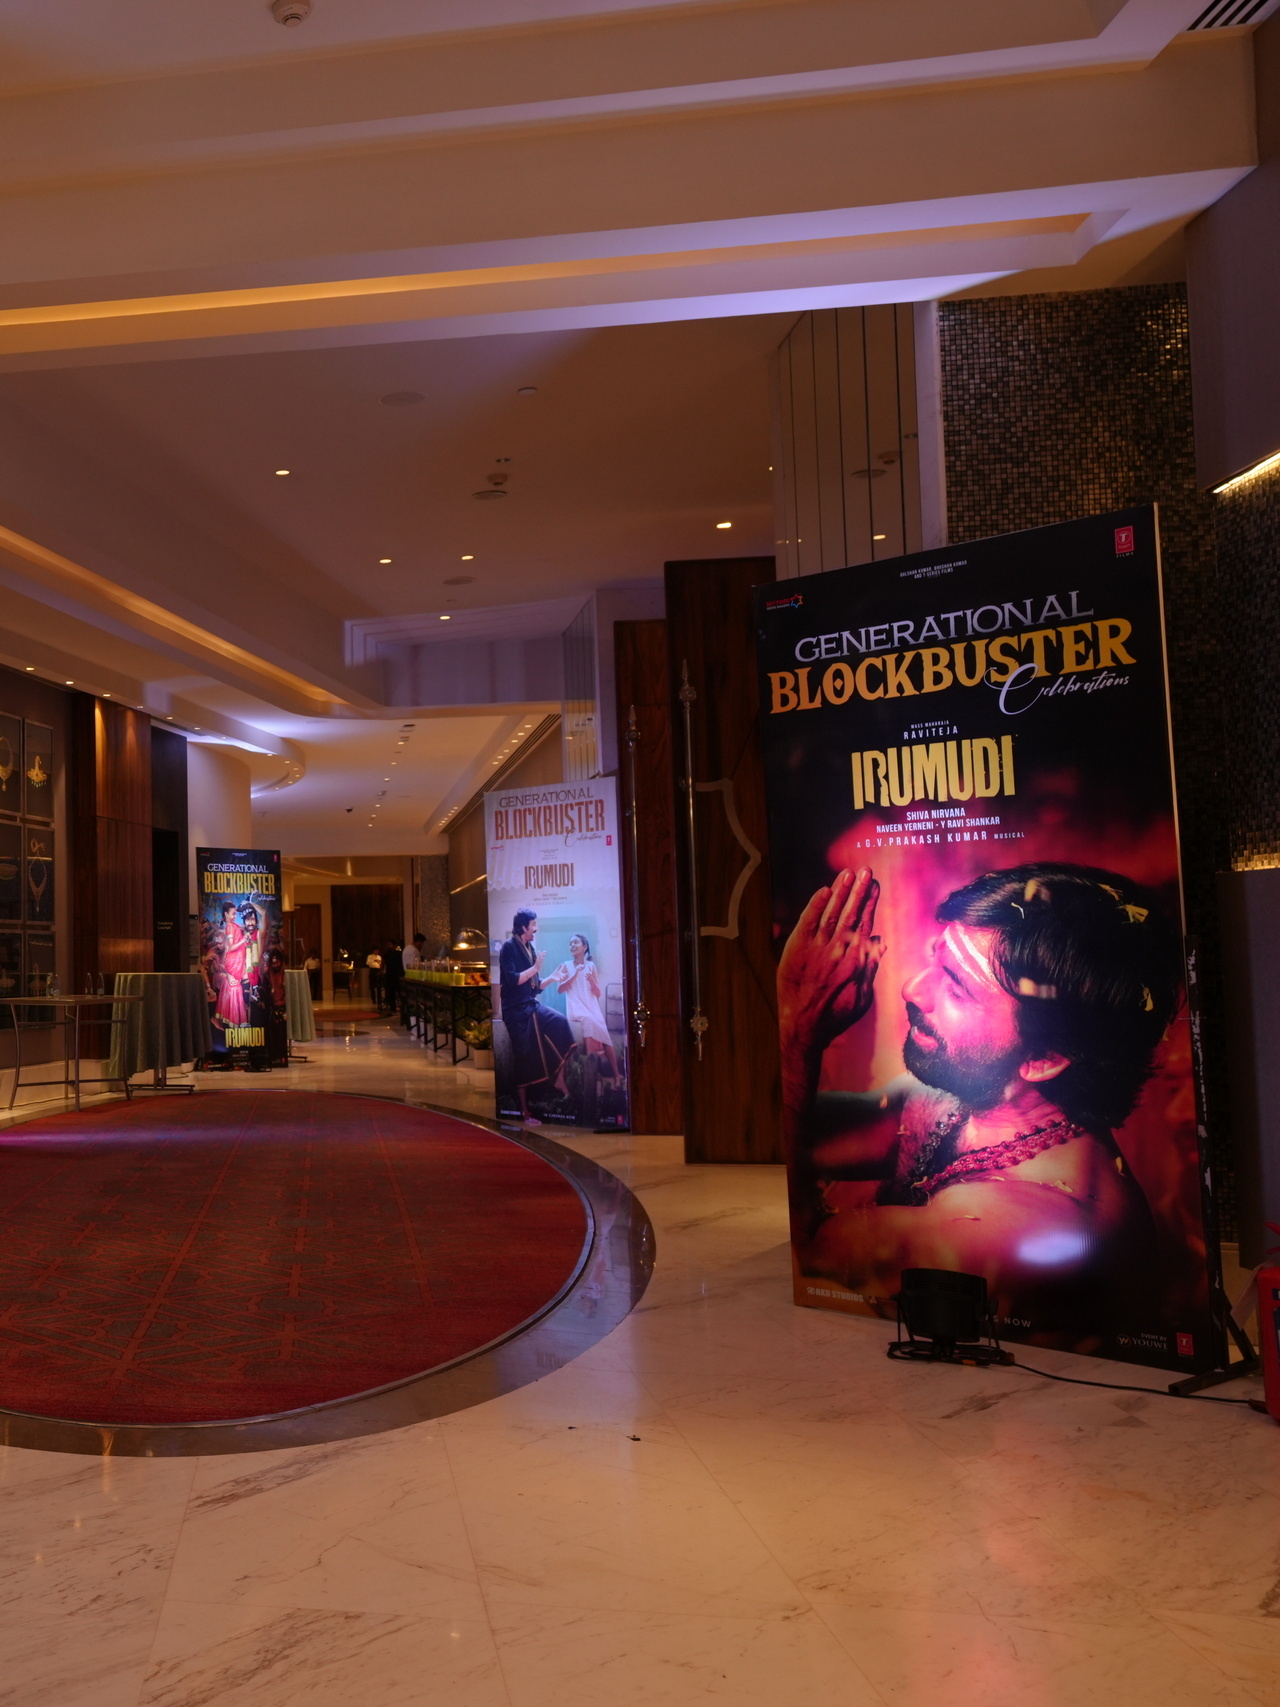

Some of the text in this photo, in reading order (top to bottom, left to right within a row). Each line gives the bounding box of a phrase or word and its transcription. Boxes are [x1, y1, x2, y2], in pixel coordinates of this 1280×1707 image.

[795, 590, 1094, 662] GENERATIONAL
[768, 617, 1137, 714] BLOCKBUSTER
[983, 663, 1130, 715] Celebrations
[904, 726, 958, 740] RAVITEJA
[851, 734, 1016, 810] IRUMUDI
[499, 787, 595, 809] GENERATIONAL
[494, 799, 606, 841] BLOCKBUSTER
[876, 824, 903, 833] NAVEEN
[904, 822, 934, 832] YERNENI
[940, 820, 945, 829] Y
[947, 819, 964, 828] RAVI
[966, 816, 1000, 827] SHANKAR
[906, 807, 966, 821] SHIVA NIRVANA
[948, 831, 987, 843] KUMAR
[994, 832, 1025, 840] MUSICAL
[207, 863, 269, 873] GENERATIONAL
[524, 863, 575, 890] IRUMUDI
[204, 871, 275, 895] BLOCKBUSTER
[225, 1027, 265, 1048] IRUMUDI
[1004, 1316, 1031, 1328] NOW
